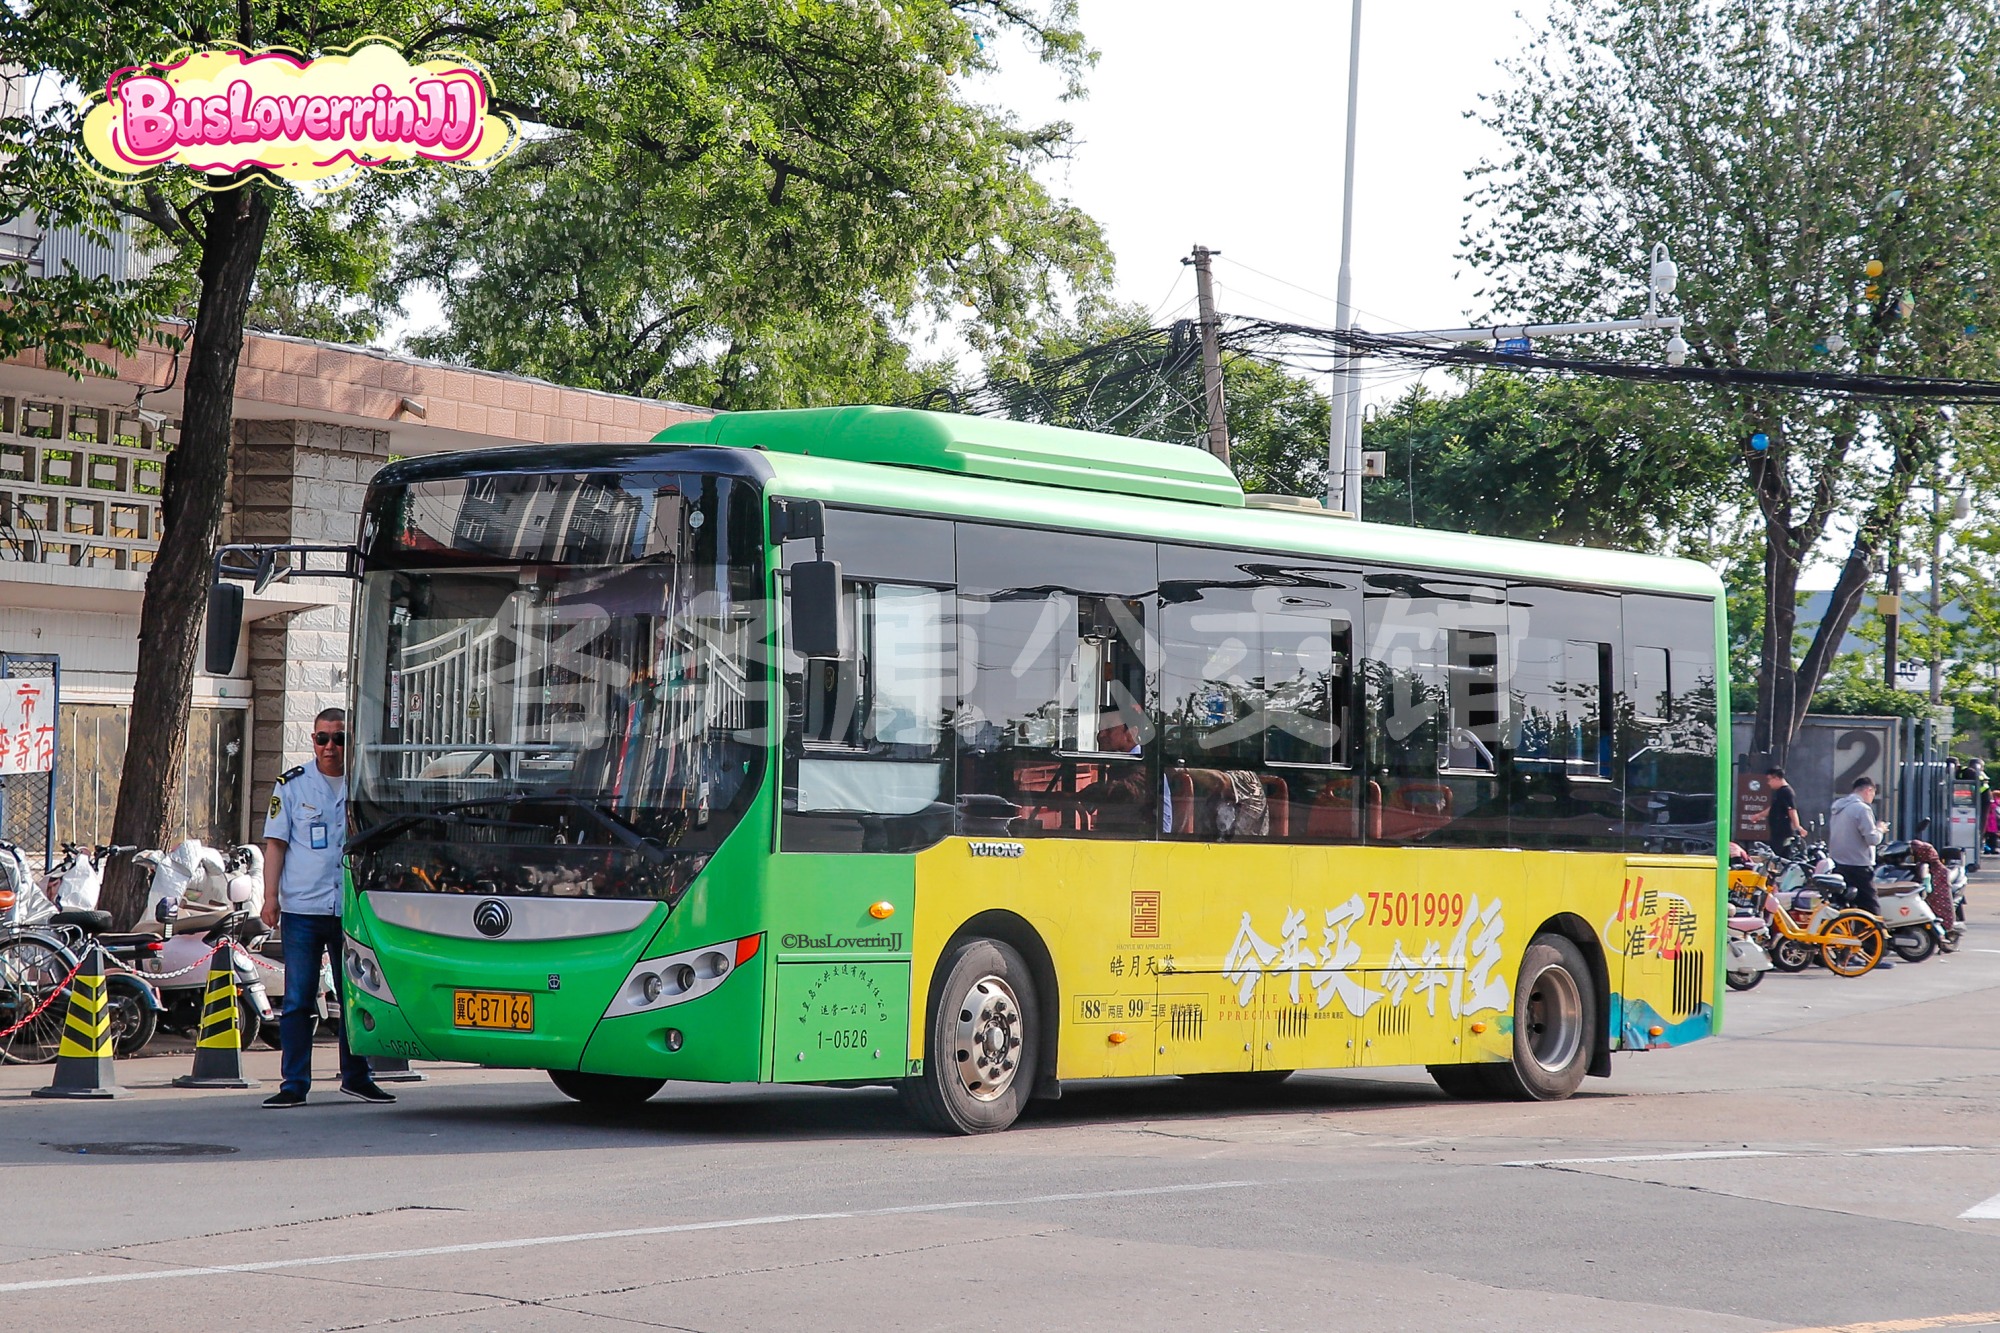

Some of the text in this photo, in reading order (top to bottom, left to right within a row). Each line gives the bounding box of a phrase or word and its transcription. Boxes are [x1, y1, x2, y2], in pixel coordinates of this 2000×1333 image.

[16, 683, 41, 724] 市
[1836, 730, 1882, 793] 2
[968, 841, 1025, 858] YUTONG
[1368, 891, 1464, 927] 7501999
[1219, 994, 1278, 1005] HAYUE
[378, 1038, 421, 1057] 1-0526
[818, 1029, 867, 1049] 1-0526
